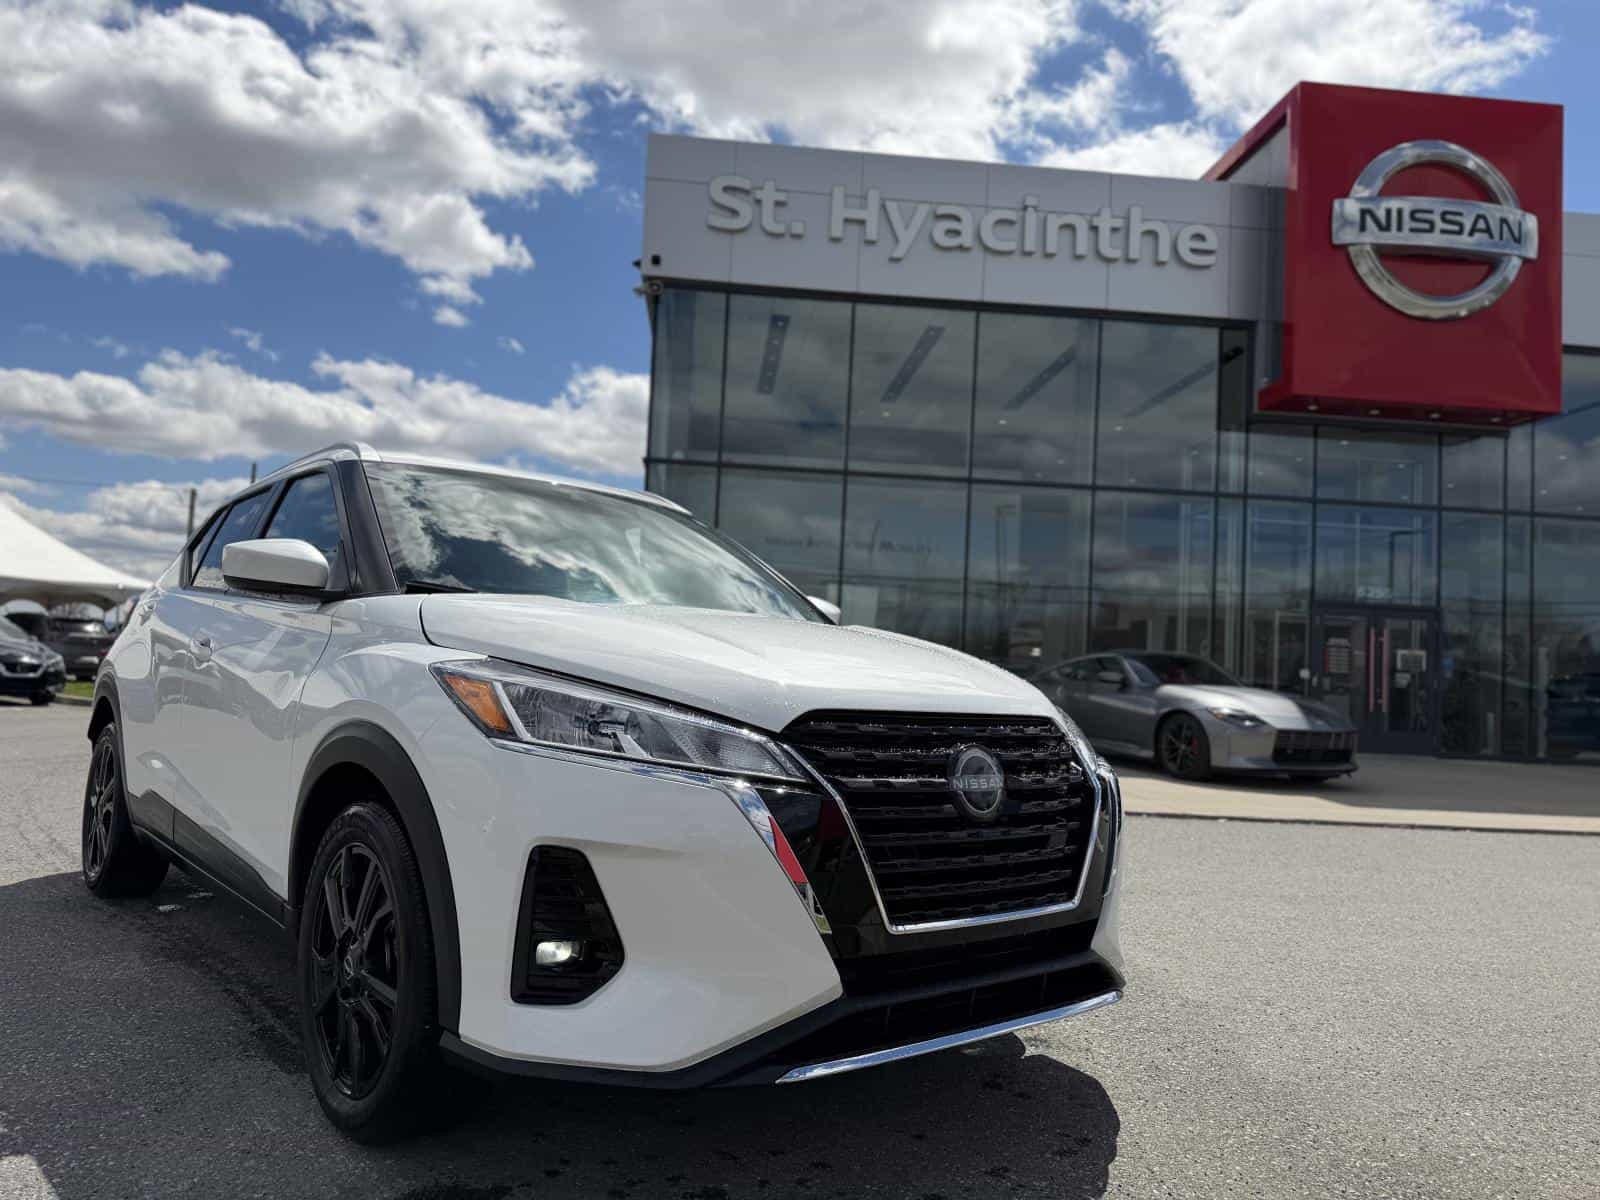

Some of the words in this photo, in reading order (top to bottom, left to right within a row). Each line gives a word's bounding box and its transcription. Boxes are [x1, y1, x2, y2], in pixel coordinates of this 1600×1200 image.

[707, 174, 805, 238] St.
[829, 185, 1219, 267] Hyacinthe
[1358, 207, 1523, 245] NISSAN
[953, 777, 1003, 789] NISSAN
